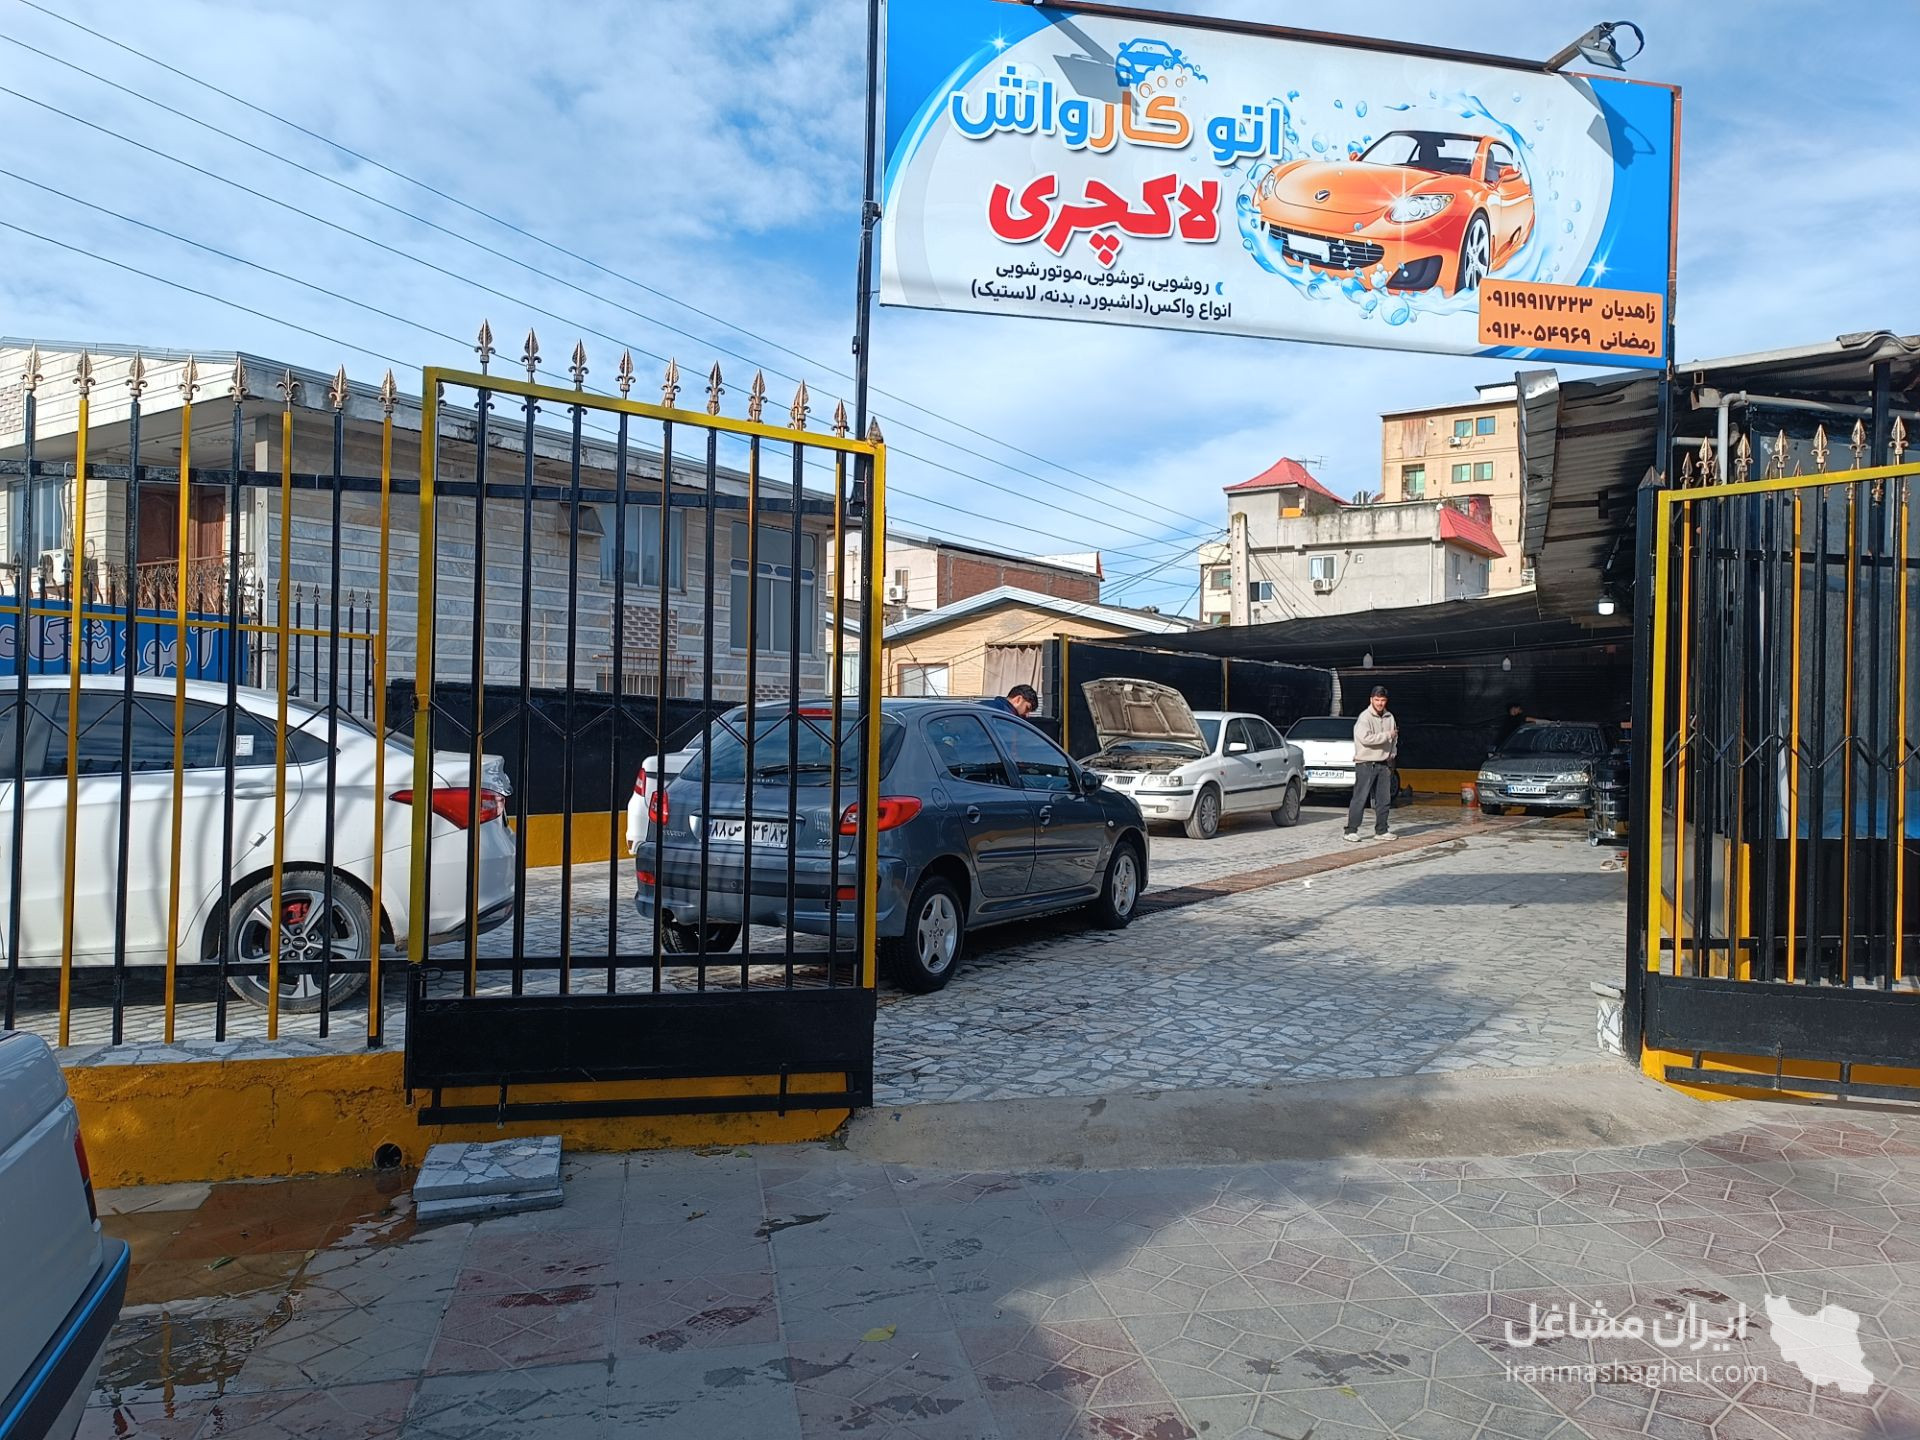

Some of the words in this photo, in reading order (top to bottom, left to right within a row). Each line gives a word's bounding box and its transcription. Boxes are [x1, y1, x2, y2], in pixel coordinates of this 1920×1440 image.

[951, 65, 1190, 148] کارواش
[1206, 104, 1284, 161] اتو
[988, 173, 1219, 266] لاکچری
[1197, 300, 1232, 321] انواع
[1486, 289, 1593, 314] ۰۹۱۱۹۹۱۷۲۲۳
[1600, 300, 1656, 324] زاهدیان
[1485, 320, 1591, 345] ۰۹۱۲۰۰۵۴۹۶۹
[1599, 330, 1656, 355] رمضانی
